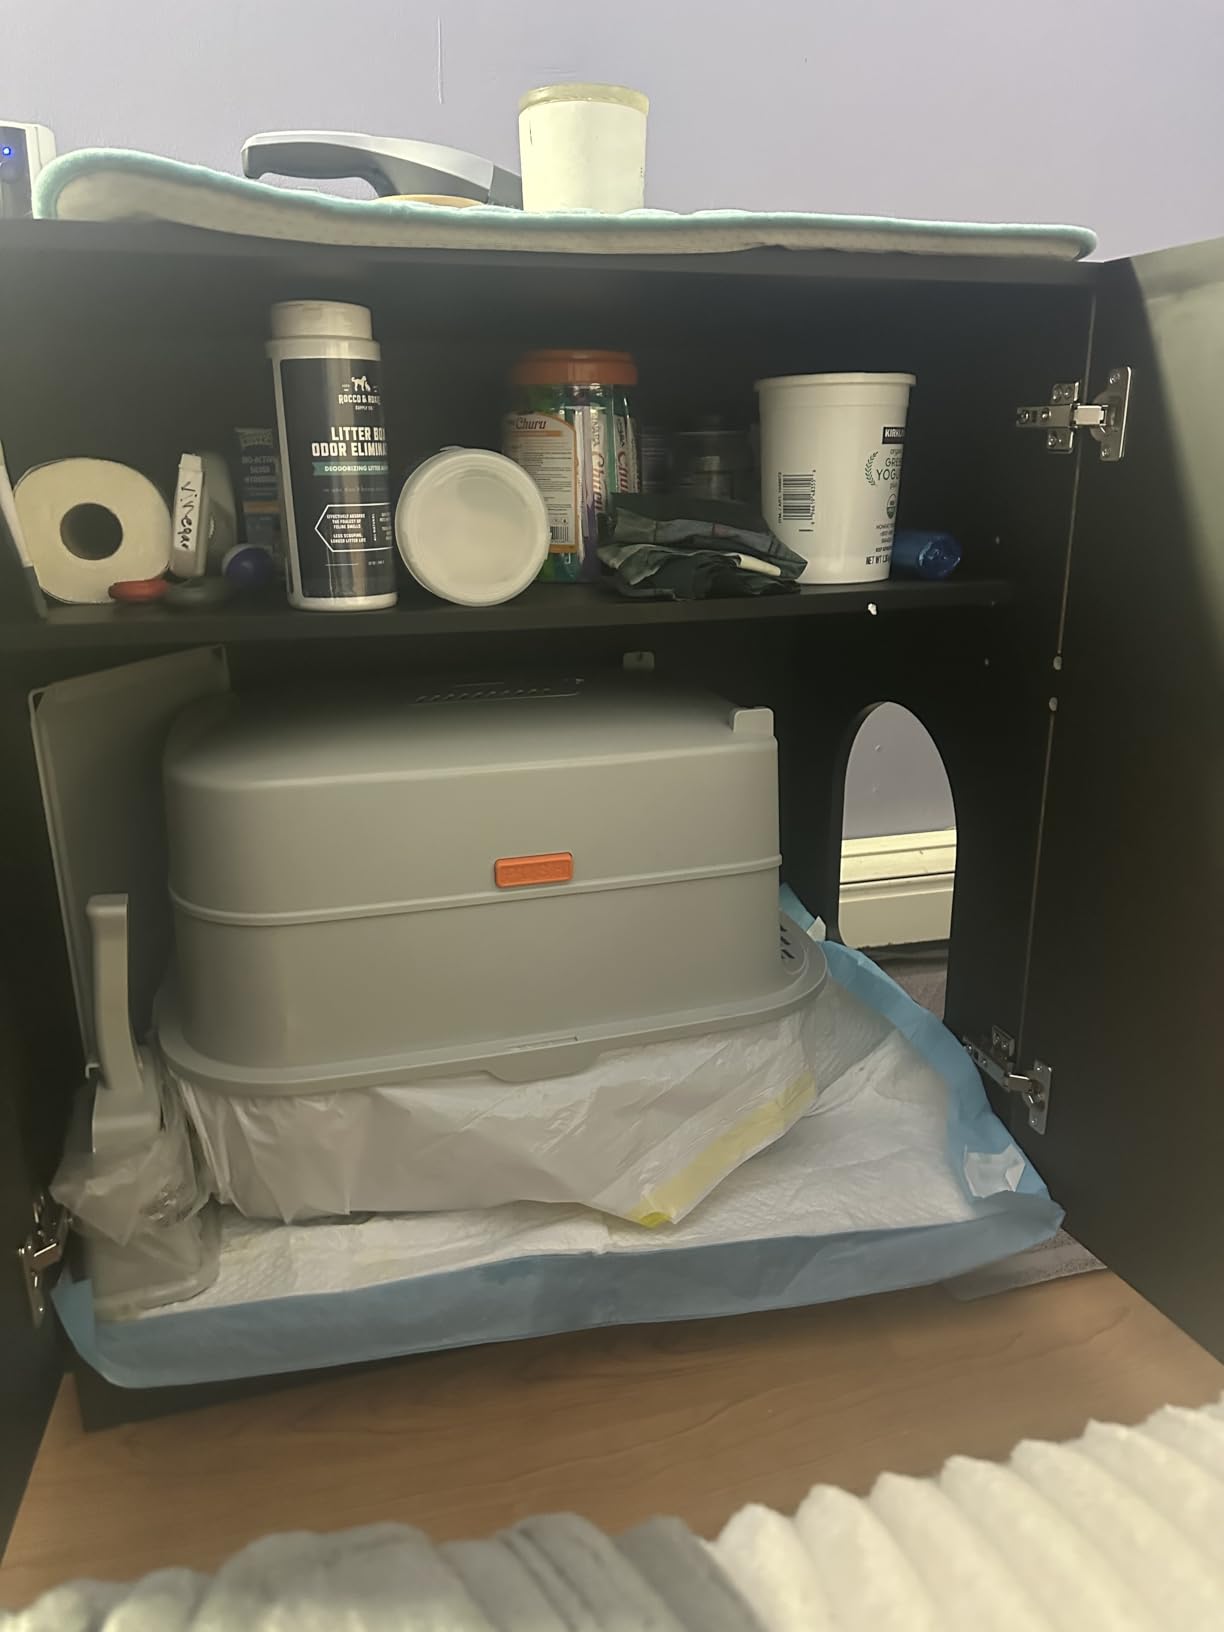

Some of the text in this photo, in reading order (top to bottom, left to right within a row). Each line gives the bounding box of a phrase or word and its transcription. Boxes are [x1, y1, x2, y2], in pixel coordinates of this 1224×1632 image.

[338, 394, 361, 404] ROCCO
[516, 417, 547, 430] Churu
[331, 426, 371, 441] LITTER
[311, 442, 347, 456] ODOR
[885, 457, 903, 467] GRE
